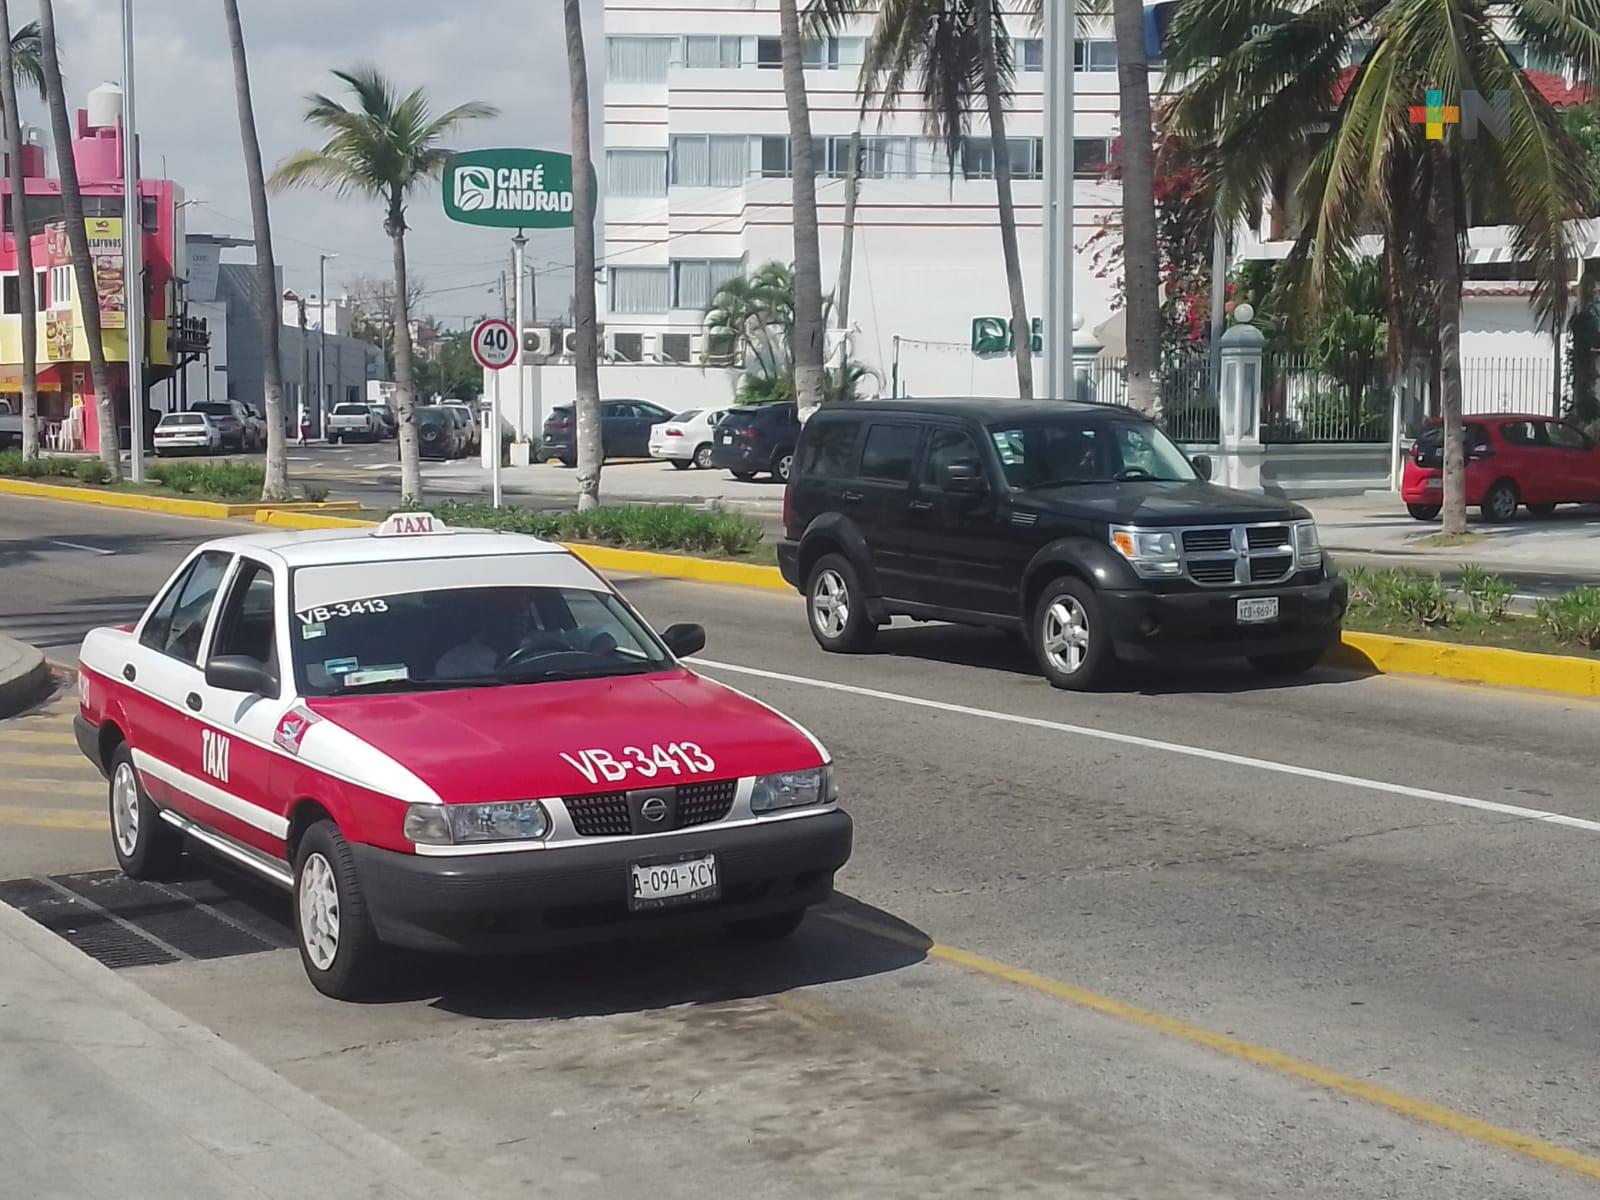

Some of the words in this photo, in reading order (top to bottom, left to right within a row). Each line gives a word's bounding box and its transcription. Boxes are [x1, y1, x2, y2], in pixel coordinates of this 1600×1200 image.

[497, 165, 545, 191] CAFÉ
[495, 189, 574, 213] ANDRAD
[483, 328, 508, 351] 40
[393, 516, 433, 533] TAXI
[296, 599, 389, 625] VB-3413
[202, 728, 230, 784] TAXI
[559, 741, 716, 784] VB-3413
[633, 863, 715, 895] A-094-XCY
